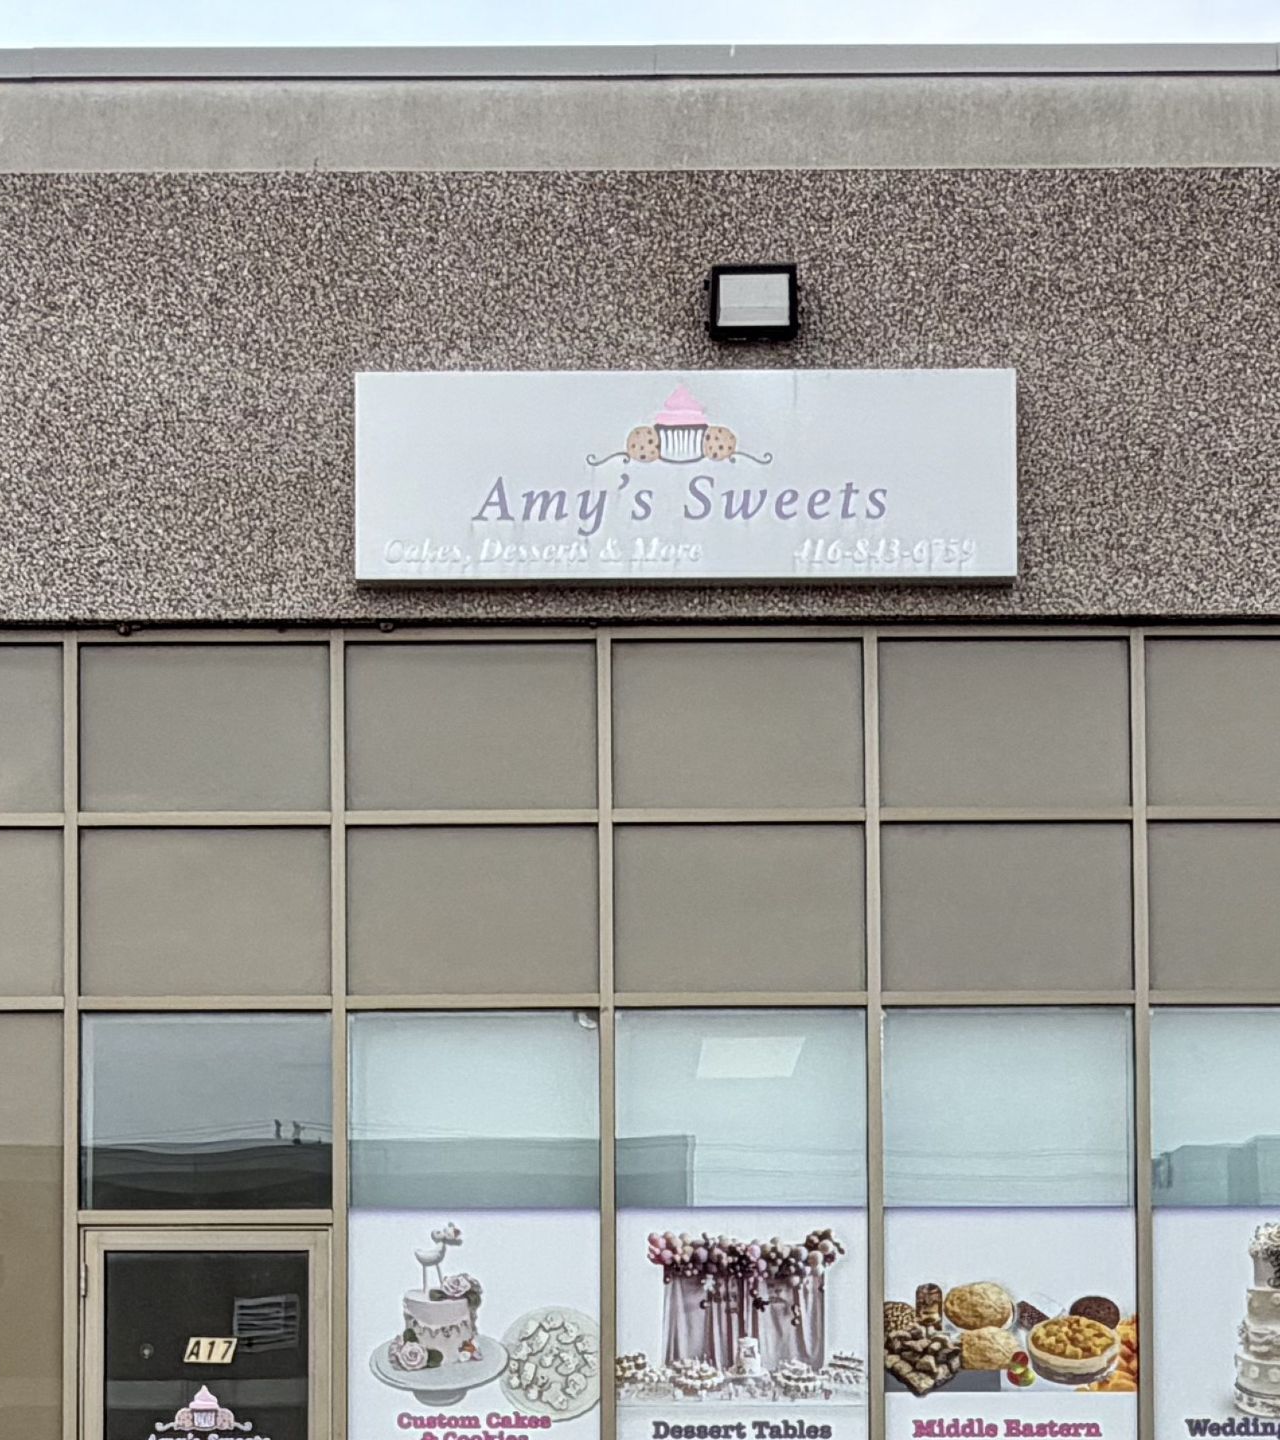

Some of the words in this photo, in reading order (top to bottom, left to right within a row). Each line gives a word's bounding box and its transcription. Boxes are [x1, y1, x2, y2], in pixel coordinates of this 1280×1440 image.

[471, 473, 654, 536] Amy's
[682, 476, 890, 521] Sweets
[383, 538, 472, 567] Cakes,
[478, 537, 591, 564] Desserts
[599, 537, 621, 563] &
[630, 537, 703, 564] More
[186, 1340, 233, 1361] A17
[397, 1411, 481, 1430] Custom
[486, 1411, 552, 1429] Cakes
[652, 1420, 747, 1440] Dessert
[752, 1419, 832, 1440] Tables
[912, 1418, 999, 1438] Middle
[1003, 1419, 1102, 1438] Eastern
